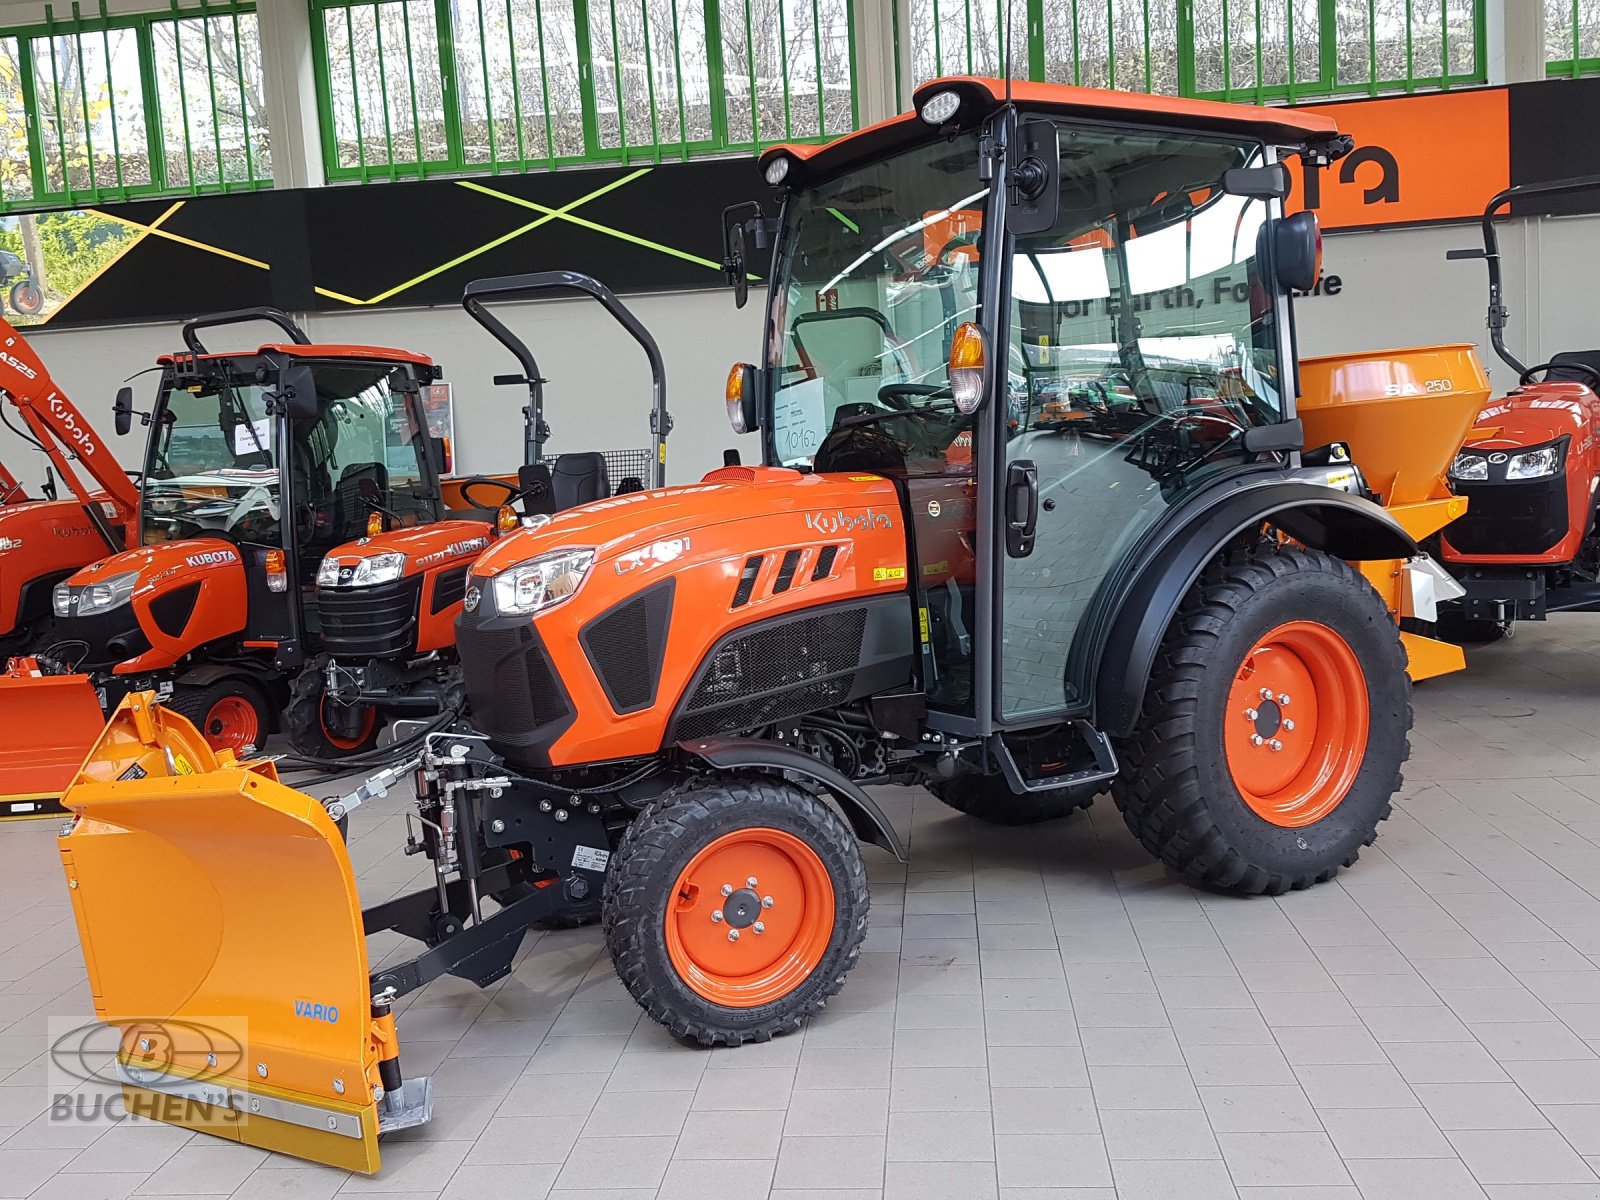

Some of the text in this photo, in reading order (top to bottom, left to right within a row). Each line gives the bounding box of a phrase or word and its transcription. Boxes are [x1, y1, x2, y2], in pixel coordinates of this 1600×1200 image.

[1059, 300, 1093, 318] or
[1213, 276, 1249, 304] Fo
[1425, 379, 1452, 393] 250
[47, 391, 95, 456] Kubota
[785, 428, 817, 455] 10162
[805, 508, 893, 534] Kubota
[185, 550, 237, 567] KUBOTA
[447, 537, 490, 557] KUBOTA
[294, 999, 339, 1024] VARIO
